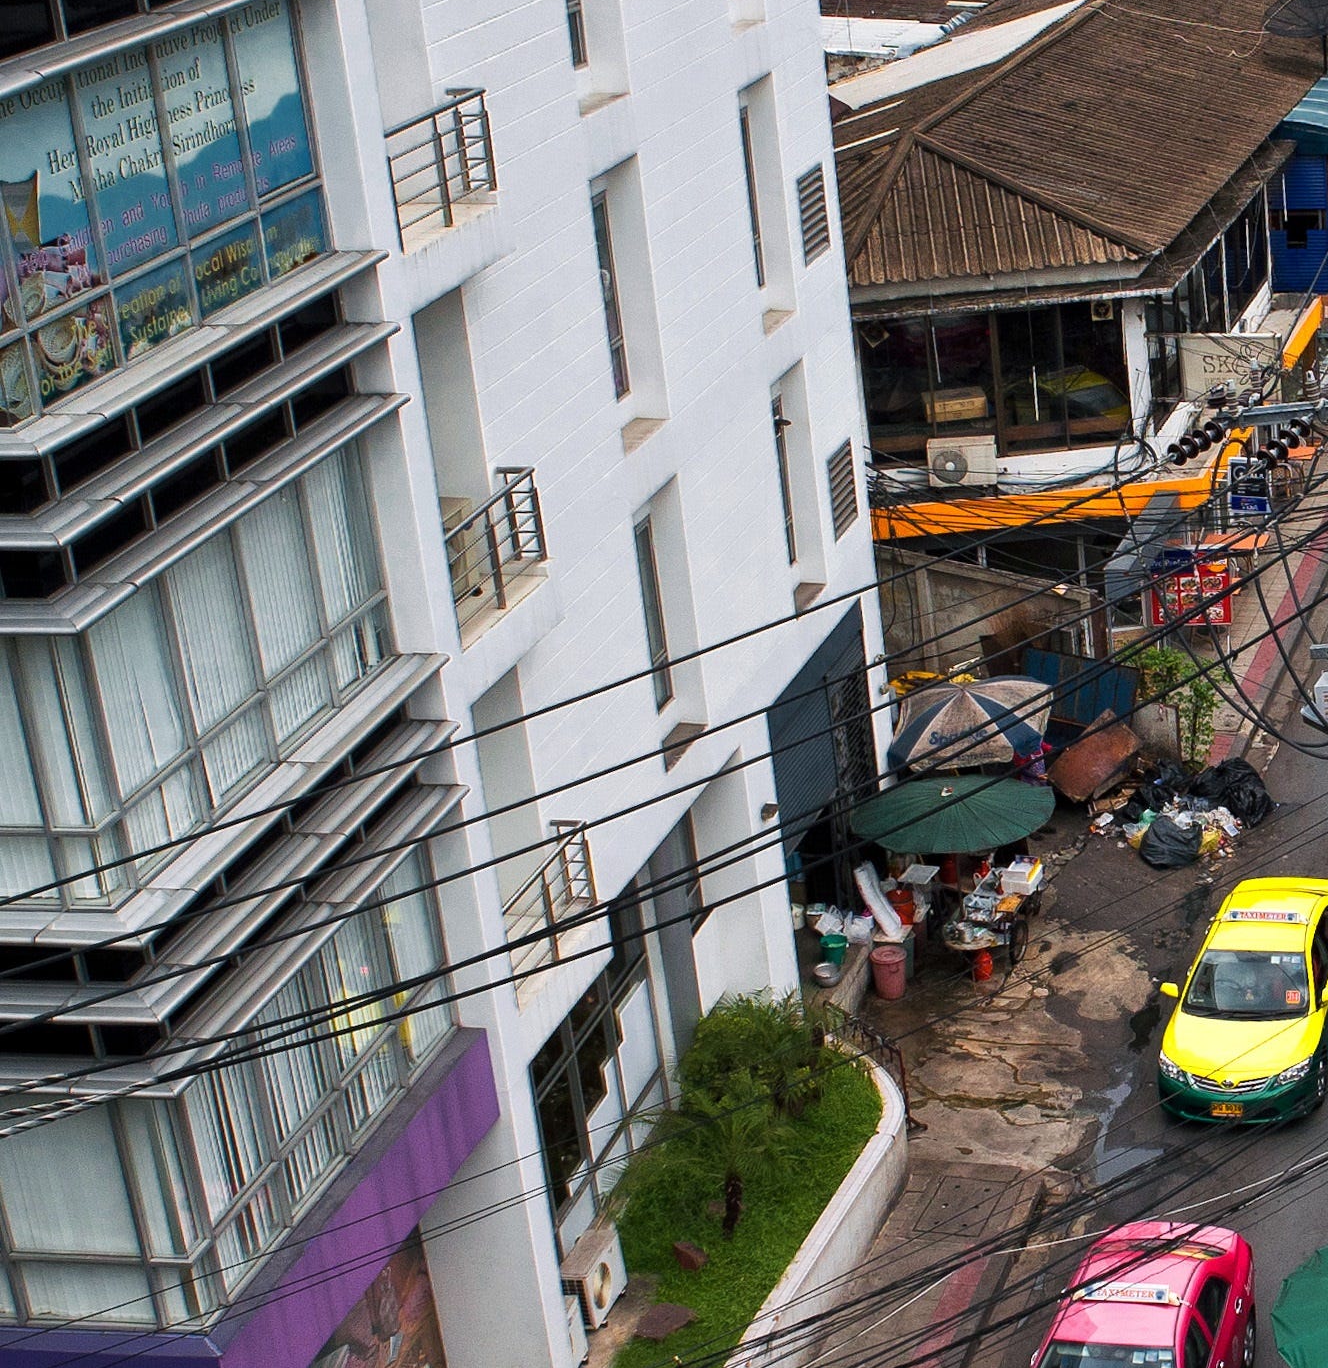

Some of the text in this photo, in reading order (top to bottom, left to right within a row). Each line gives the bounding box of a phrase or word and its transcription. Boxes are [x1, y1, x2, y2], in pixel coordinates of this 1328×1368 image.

[243, 0, 280, 29] Under
[92, 94, 115, 120] the
[189, 56, 201, 83] of
[48, 148, 77, 175] Her
[86, 122, 126, 159] Royal
[122, 201, 145, 227] and
[269, 133, 297, 158] Areas
